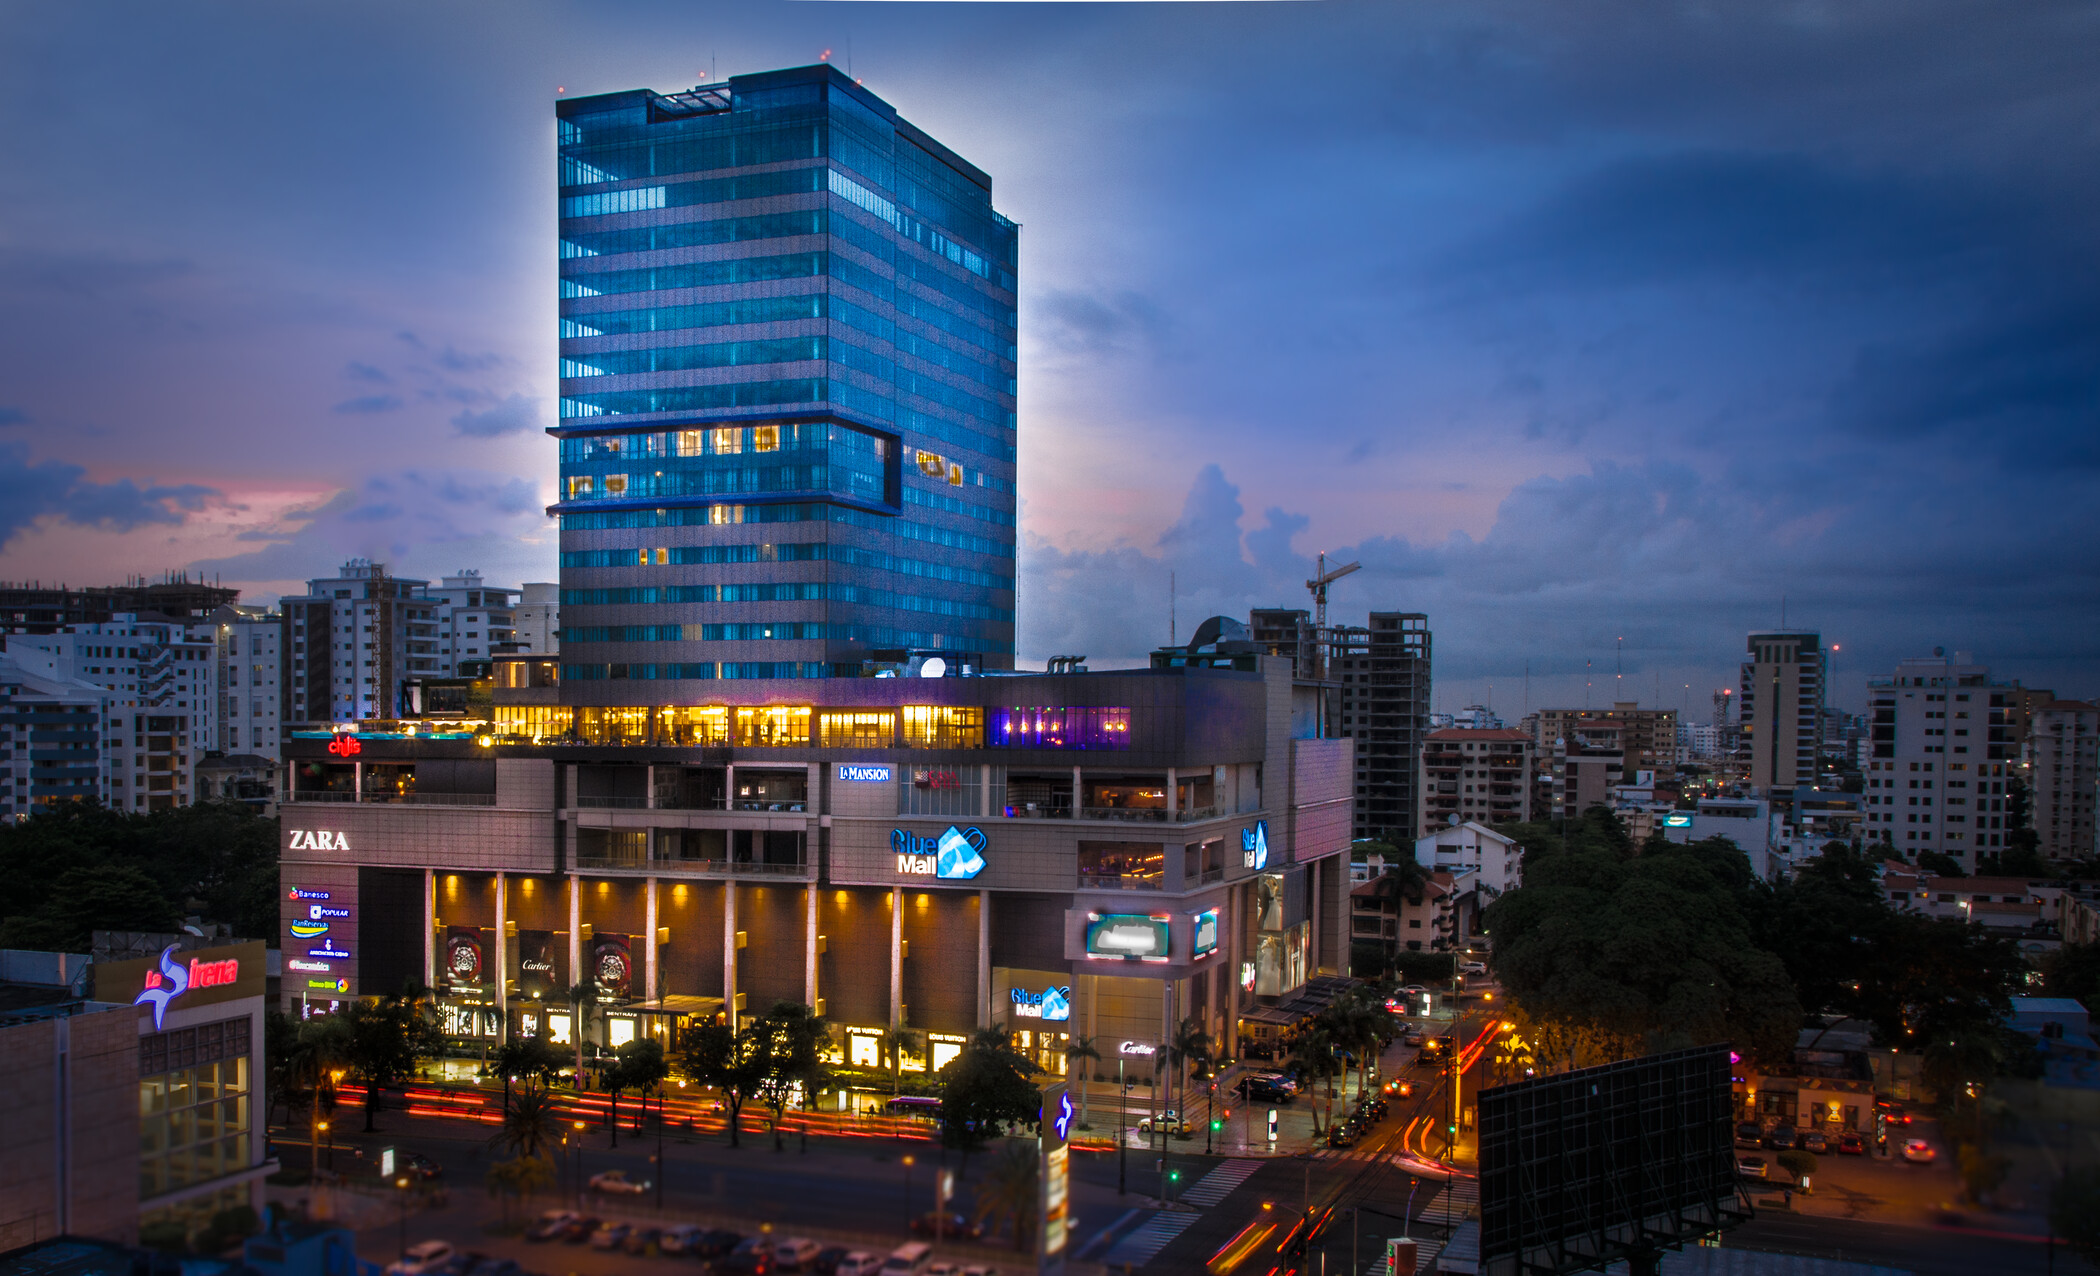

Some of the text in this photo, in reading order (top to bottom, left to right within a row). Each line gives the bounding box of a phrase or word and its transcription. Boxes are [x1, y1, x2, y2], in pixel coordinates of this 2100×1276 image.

[849, 766, 889, 780] MANSION
[290, 830, 350, 850] ZARA
[890, 829, 937, 855] Blue
[1242, 828, 1256, 850] Blue
[897, 855, 937, 874] Mall
[1243, 850, 1255, 868] Mall
[299, 890, 330, 899] Banesco
[321, 909, 350, 917] POPULAR
[522, 959, 551, 971] Cartier
[145, 970, 162, 989] La
[1011, 988, 1042, 1005] Blue
[1016, 1003, 1042, 1018] Mall
[1120, 1041, 1156, 1055] Cartier
